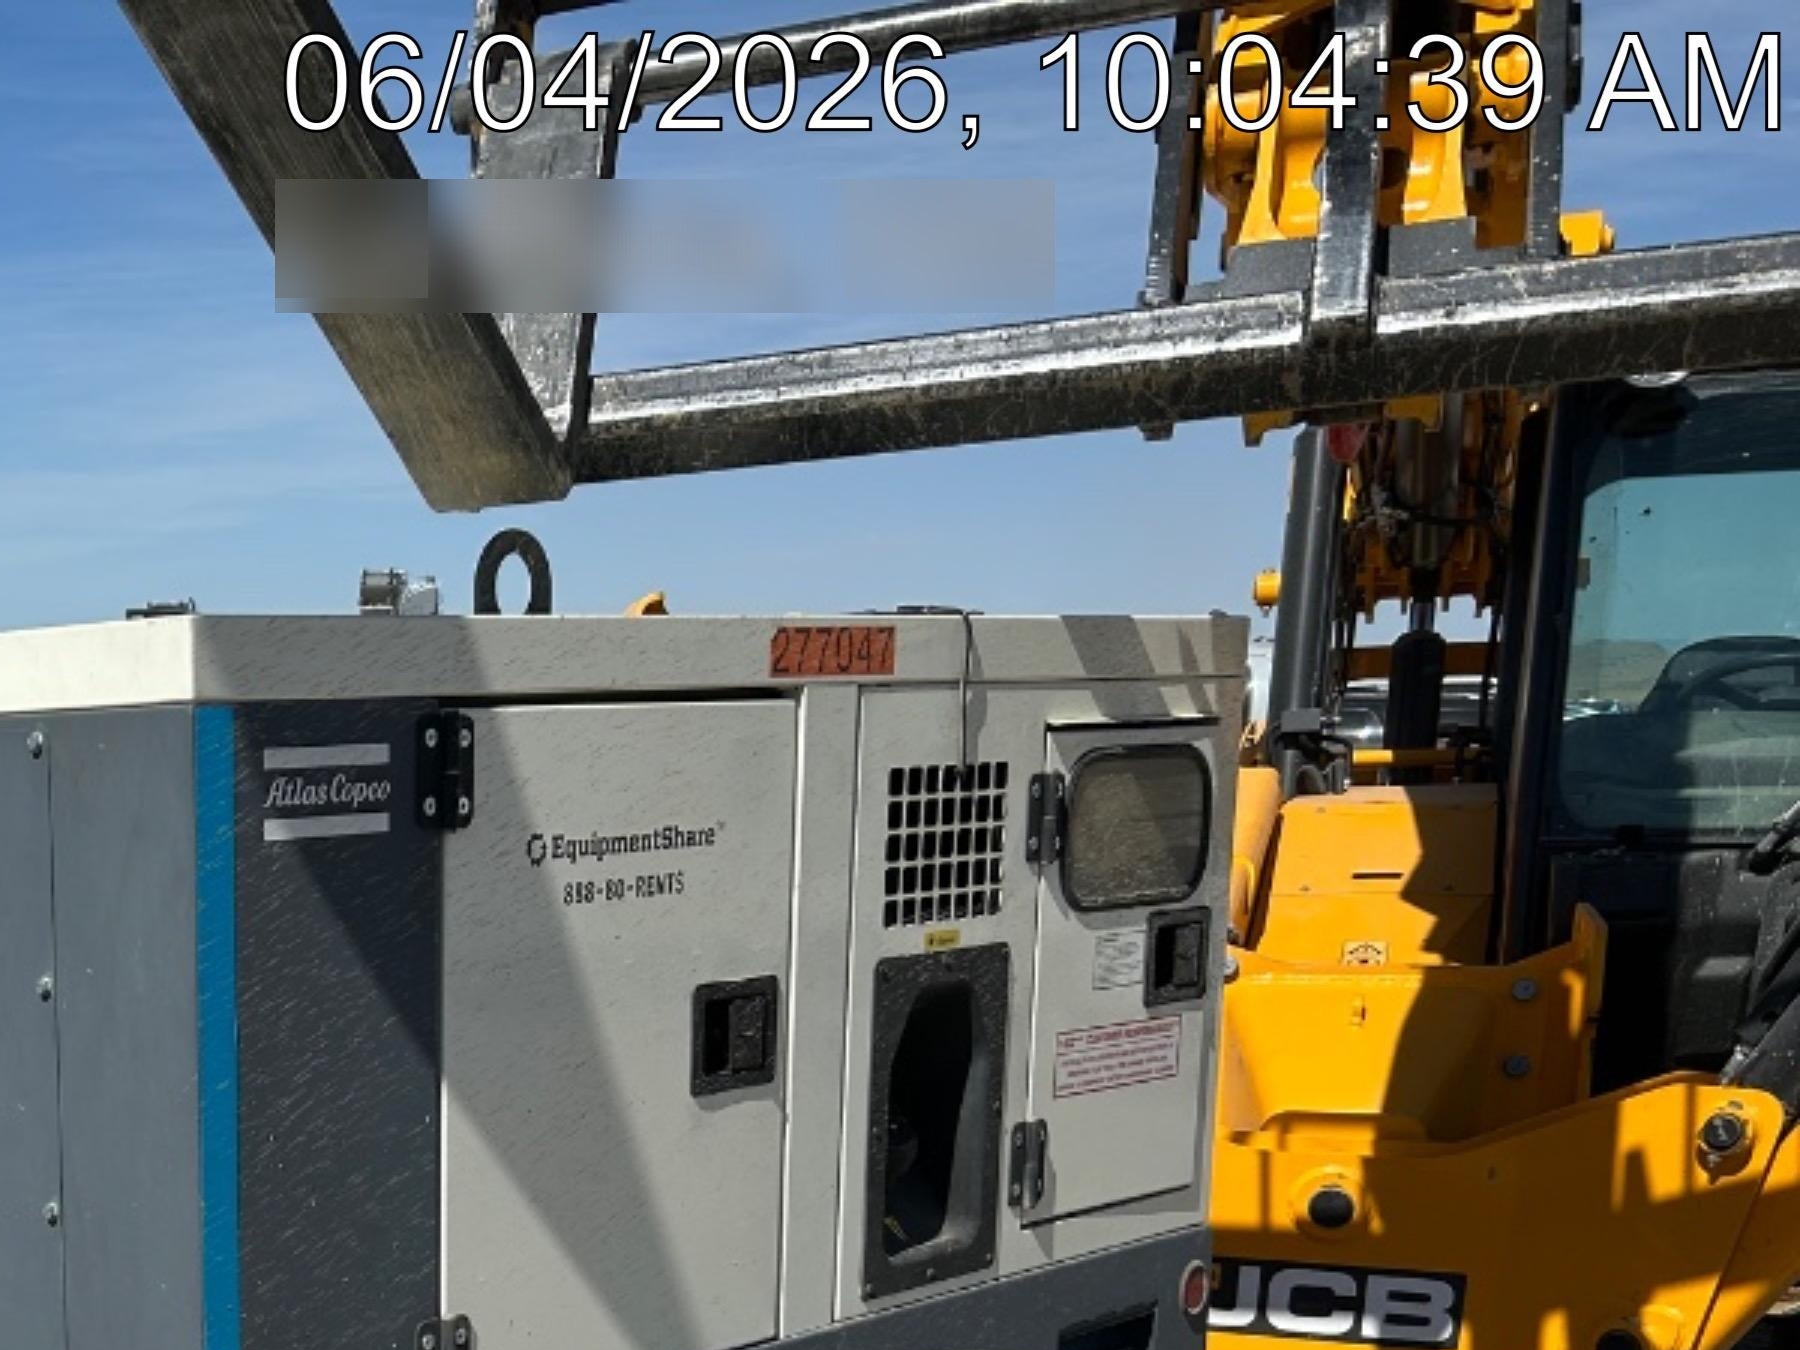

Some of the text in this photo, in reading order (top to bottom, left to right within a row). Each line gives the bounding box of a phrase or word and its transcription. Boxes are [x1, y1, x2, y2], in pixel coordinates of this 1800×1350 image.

[773, 626, 895, 674] 277047
[261, 772, 392, 809] Atlas Copco
[1207, 1265, 1456, 1343] JCB
